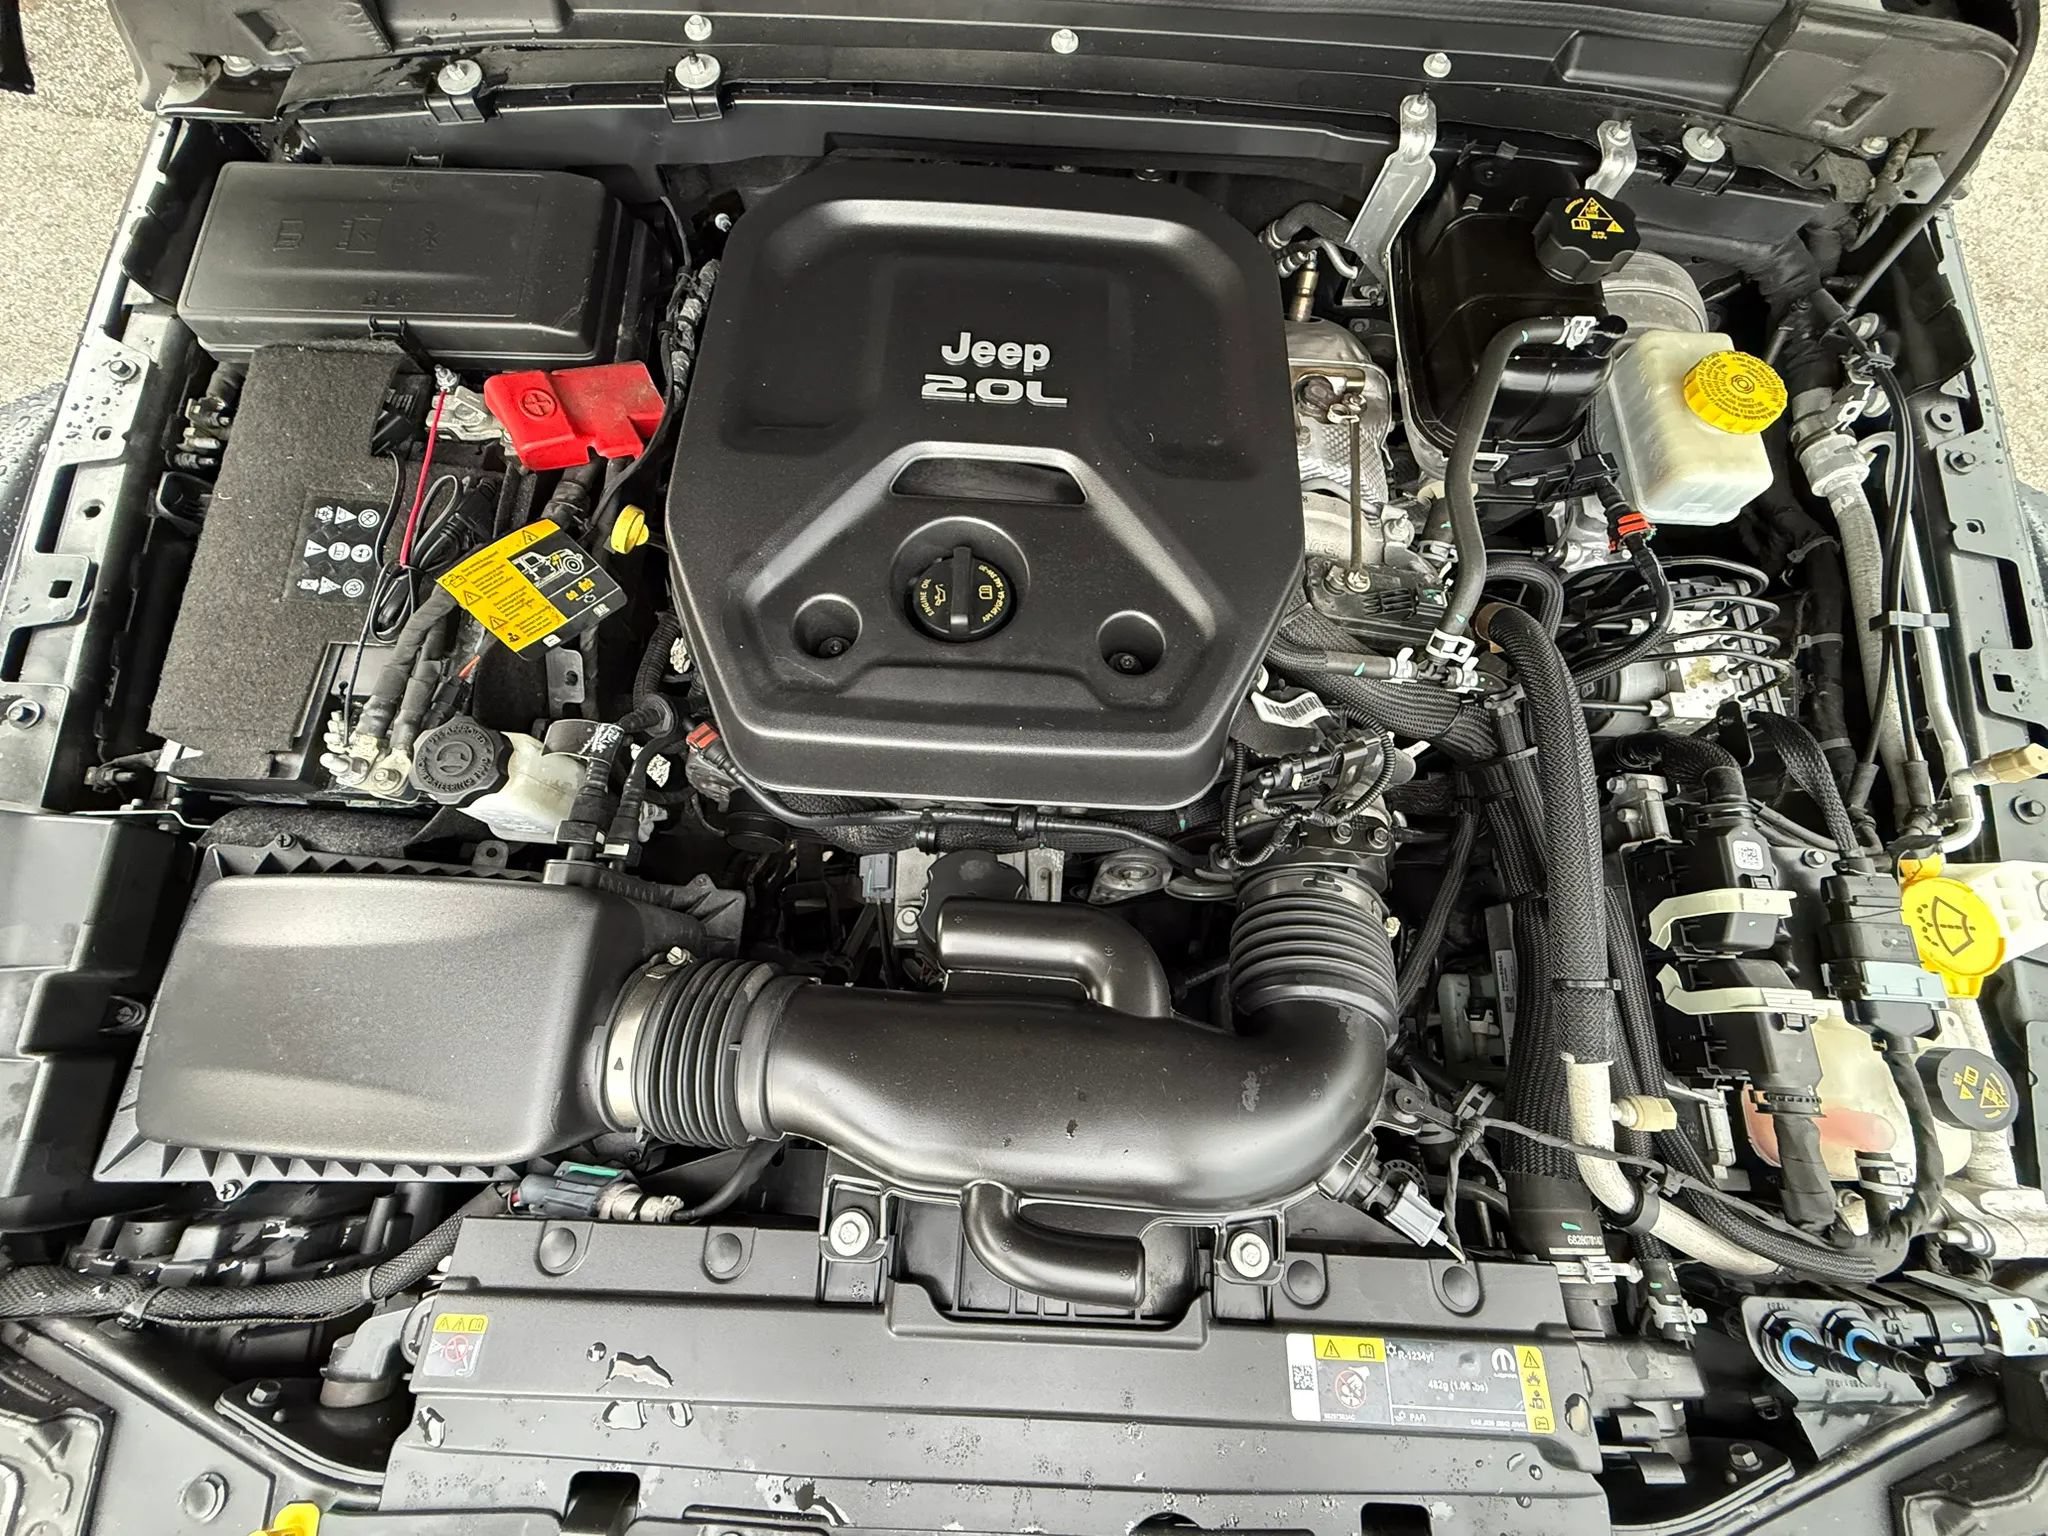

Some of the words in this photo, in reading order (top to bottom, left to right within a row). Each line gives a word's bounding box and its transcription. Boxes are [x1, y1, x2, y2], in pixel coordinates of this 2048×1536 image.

[941, 332, 1050, 375] Jeep
[921, 374, 1068, 407] 2.0L
[921, 578, 932, 589] OIL
[919, 591, 935, 617] ENGINE
[982, 611, 994, 622] API
[446, 725, 486, 745] APPROVED
